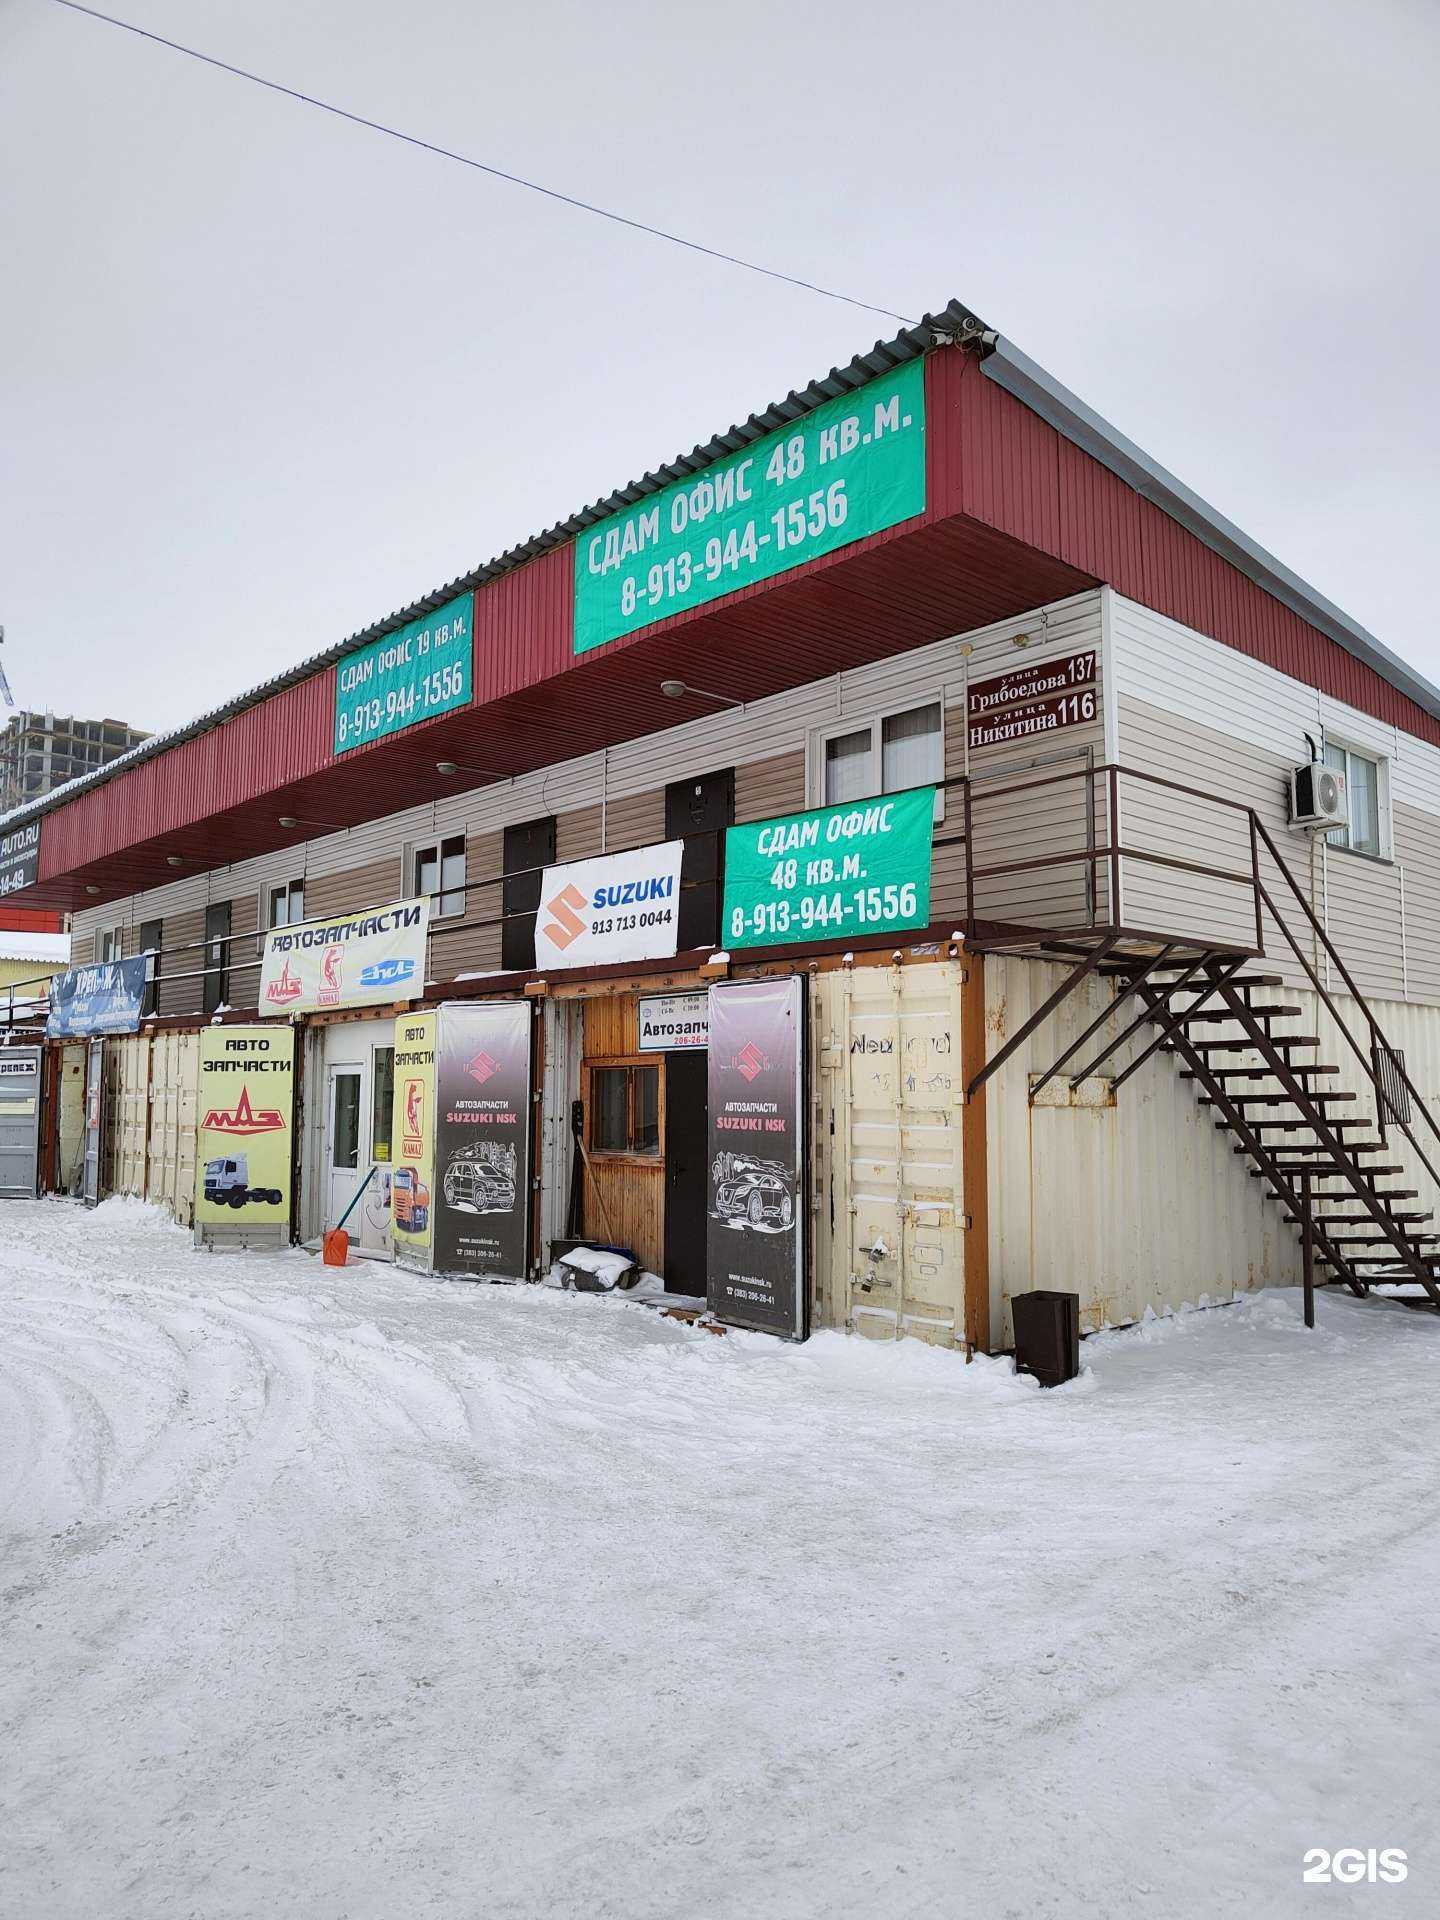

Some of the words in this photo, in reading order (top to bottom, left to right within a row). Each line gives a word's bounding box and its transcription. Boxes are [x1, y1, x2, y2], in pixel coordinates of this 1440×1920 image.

[588, 505, 660, 576] СДАМ
[670, 458, 753, 534] ОФИС
[766, 435, 805, 487] 48
[620, 478, 848, 617] 8-913-944-1556
[341, 657, 374, 693] СДАМ
[377, 638, 412, 674] ОФИС
[417, 630, 430, 656] 19
[970, 673, 1066, 711] Грибоедова
[1068, 654, 1094, 682] 137
[1001, 669, 1039, 686] улица
[339, 661, 463, 742] 8-913-944-1556
[993, 704, 1046, 724] улица
[969, 713, 1058, 747] Никитина
[1058, 692, 1094, 724] 116
[757, 819, 820, 858] СДАМ
[826, 803, 895, 843] ОФИС
[770, 859, 798, 891] 48
[592, 875, 673, 909] SUZUKI
[592, 919, 613, 935] 913
[617, 915, 637, 931] 713
[640, 909, 672, 927] 0044
[731, 882, 917, 938] 8-913-944-1556
[271, 905, 421, 953] АВТОЗАПЧАСТИ
[225, 1039, 270, 1051] АВТО
[405, 1027, 425, 1041] АВТО
[203, 1060, 291, 1072] ЗАПЧАСТИ
[395, 1050, 435, 1067] ЗАПЧАСТИ
[446, 1112, 493, 1123] SUZUKI
[496, 1113, 517, 1124] NSK
[455, 1100, 509, 1109] АВТОЗАПЧАСТИ
[725, 1102, 777, 1113] АВТОЗАПЧАСТИ
[716, 1116, 762, 1131] SUZUKI
[765, 1119, 786, 1132] NSK
